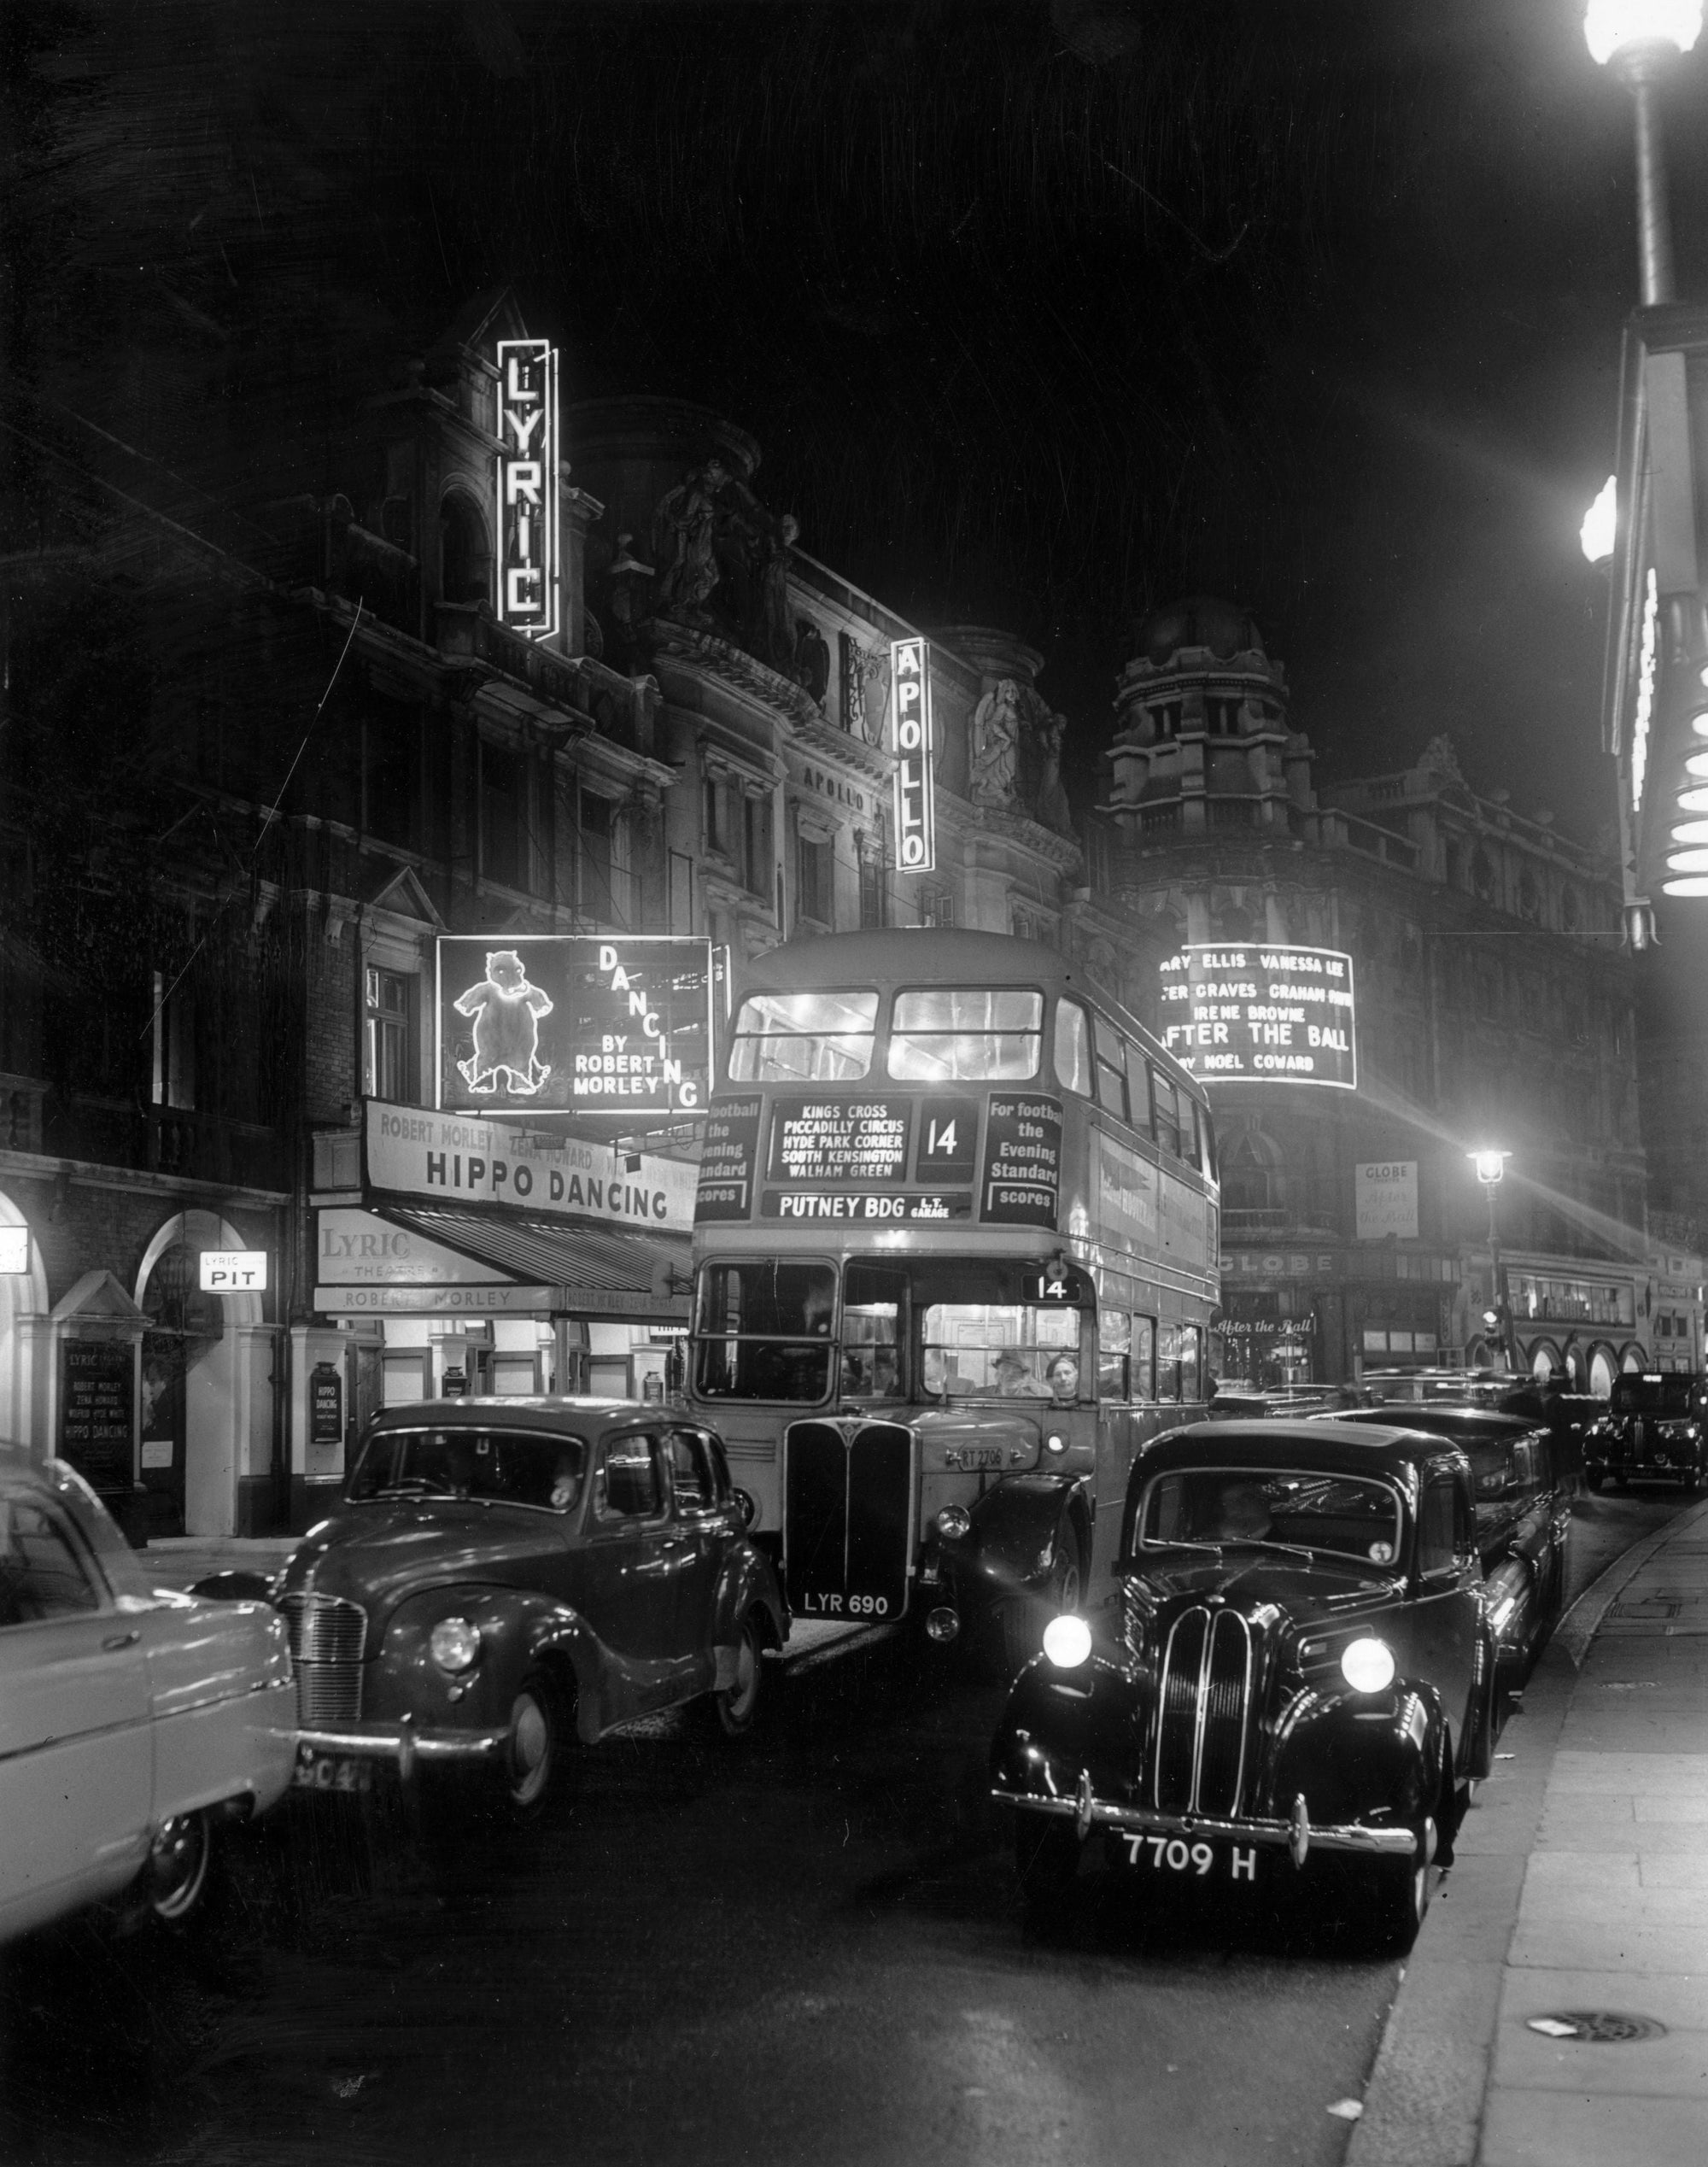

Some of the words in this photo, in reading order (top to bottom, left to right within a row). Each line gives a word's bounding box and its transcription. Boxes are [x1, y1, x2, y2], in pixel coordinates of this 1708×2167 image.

[504, 357, 544, 612] LYRIC
[896, 647, 923, 865] APOLLO
[804, 767, 863, 810] APOLLO
[1202, 953, 1246, 969] ELLIS
[1260, 954, 1322, 973] VANESSA
[1325, 960, 1345, 978] LEE
[1196, 983, 1257, 999] GRAVES
[1269, 984, 1325, 1004] GRAHAM
[1194, 1004, 1241, 1021] IRENE
[1247, 1005, 1306, 1023] BROWNE
[602, 1034, 628, 1052] BY
[1248, 1022, 1293, 1045] THE
[1307, 1025, 1349, 1051] BALL
[575, 1055, 655, 1074] ROBERT
[1253, 1054, 1314, 1072] COWARD
[574, 1076, 658, 1094] MORLEY
[802, 1105, 840, 1119] KINGS
[847, 1104, 887, 1118] CROSS
[991, 1102, 1015, 1116] For
[381, 1113, 434, 1144] ROBERT
[442, 1122, 494, 1151] MORLEY
[709, 1123, 729, 1139] the
[784, 1120, 855, 1134] PICCADILLY
[859, 1120, 904, 1133] CIRCUS
[1018, 1122, 1044, 1138] the
[782, 1135, 816, 1149] HYDE
[819, 1135, 851, 1149] PARK
[855, 1135, 903, 1149] CORNER
[927, 1118, 957, 1155] 14
[781, 1150, 822, 1163] SOUTH
[828, 1150, 904, 1163] KENSINGTON
[999, 1141, 1056, 1165] Evening
[788, 1164, 843, 1178] WALHAM
[849, 1163, 892, 1177] GREEN
[991, 1162, 1057, 1185] Standard
[1366, 1165, 1407, 1179] GLOBE
[426, 1151, 533, 1197] HIPPO
[550, 1169, 668, 1220] DANCING
[779, 1196, 860, 1217] PUTNEY
[864, 1197, 905, 1218] BDG
[921, 1197, 943, 1208] L.T.
[999, 1191, 1050, 1207] scores
[910, 1207, 950, 1219] GARAGE
[322, 1228, 410, 1260] LYRIC
[205, 1256, 238, 1266] LYRIC
[1220, 1256, 1331, 1271] GLOBE
[211, 1271, 255, 1286] PIT
[1038, 1275, 1068, 1299] 14
[346, 1292, 418, 1307] ROBE
[435, 1291, 511, 1307] MORLEY
[1214, 1320, 1252, 1336] After
[1255, 1320, 1275, 1333] the
[69, 1354, 98, 1367] LYRIC
[318, 1386, 336, 1397] HIPPO
[316, 1399, 337, 1409] DANCING
[92, 1425, 128, 1438] DANCING
[962, 1450, 975, 1467] RT
[804, 1592, 843, 1612] LYR
[849, 1595, 888, 1615] 690
[1122, 1832, 1214, 1875] 7709
[1231, 1846, 1257, 1881] H
